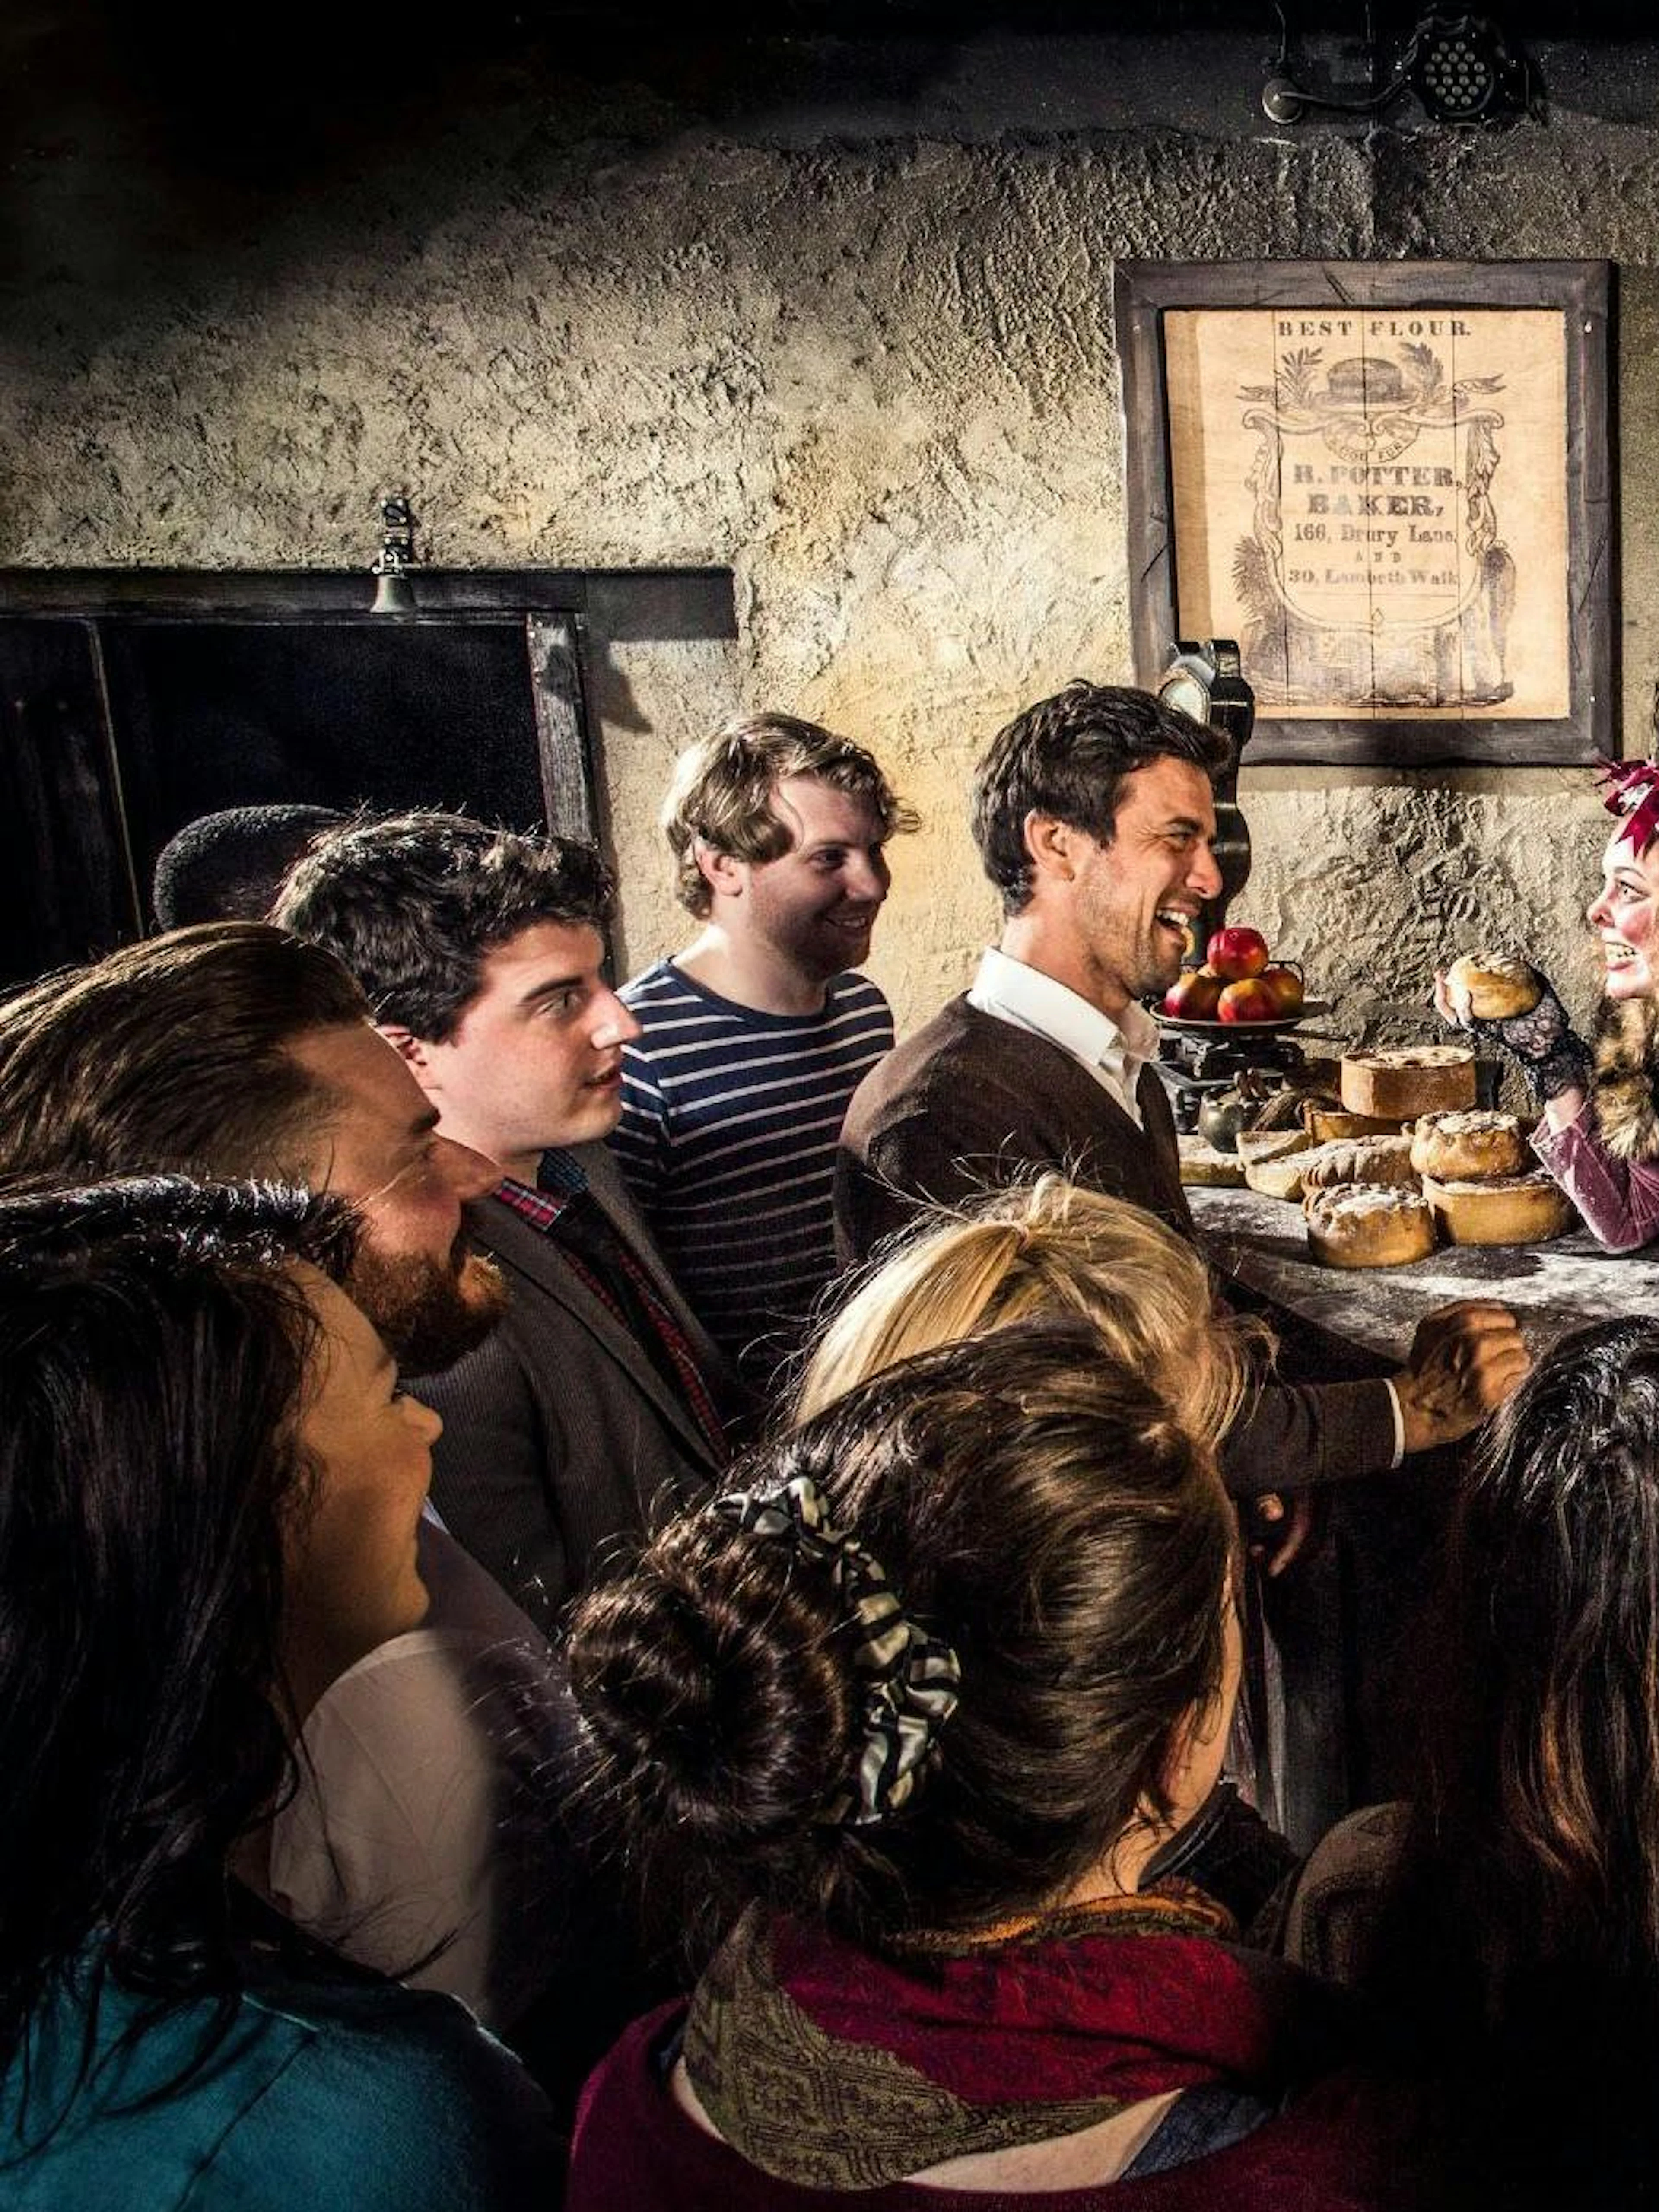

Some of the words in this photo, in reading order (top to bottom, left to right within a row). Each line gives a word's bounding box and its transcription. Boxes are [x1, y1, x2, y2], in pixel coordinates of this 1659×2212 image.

[1278, 321, 1352, 336] BEST
[1370, 321, 1471, 336] FLOUR.
[1309, 494, 1444, 516] BAKER,
[1341, 523, 1398, 548] Drury
